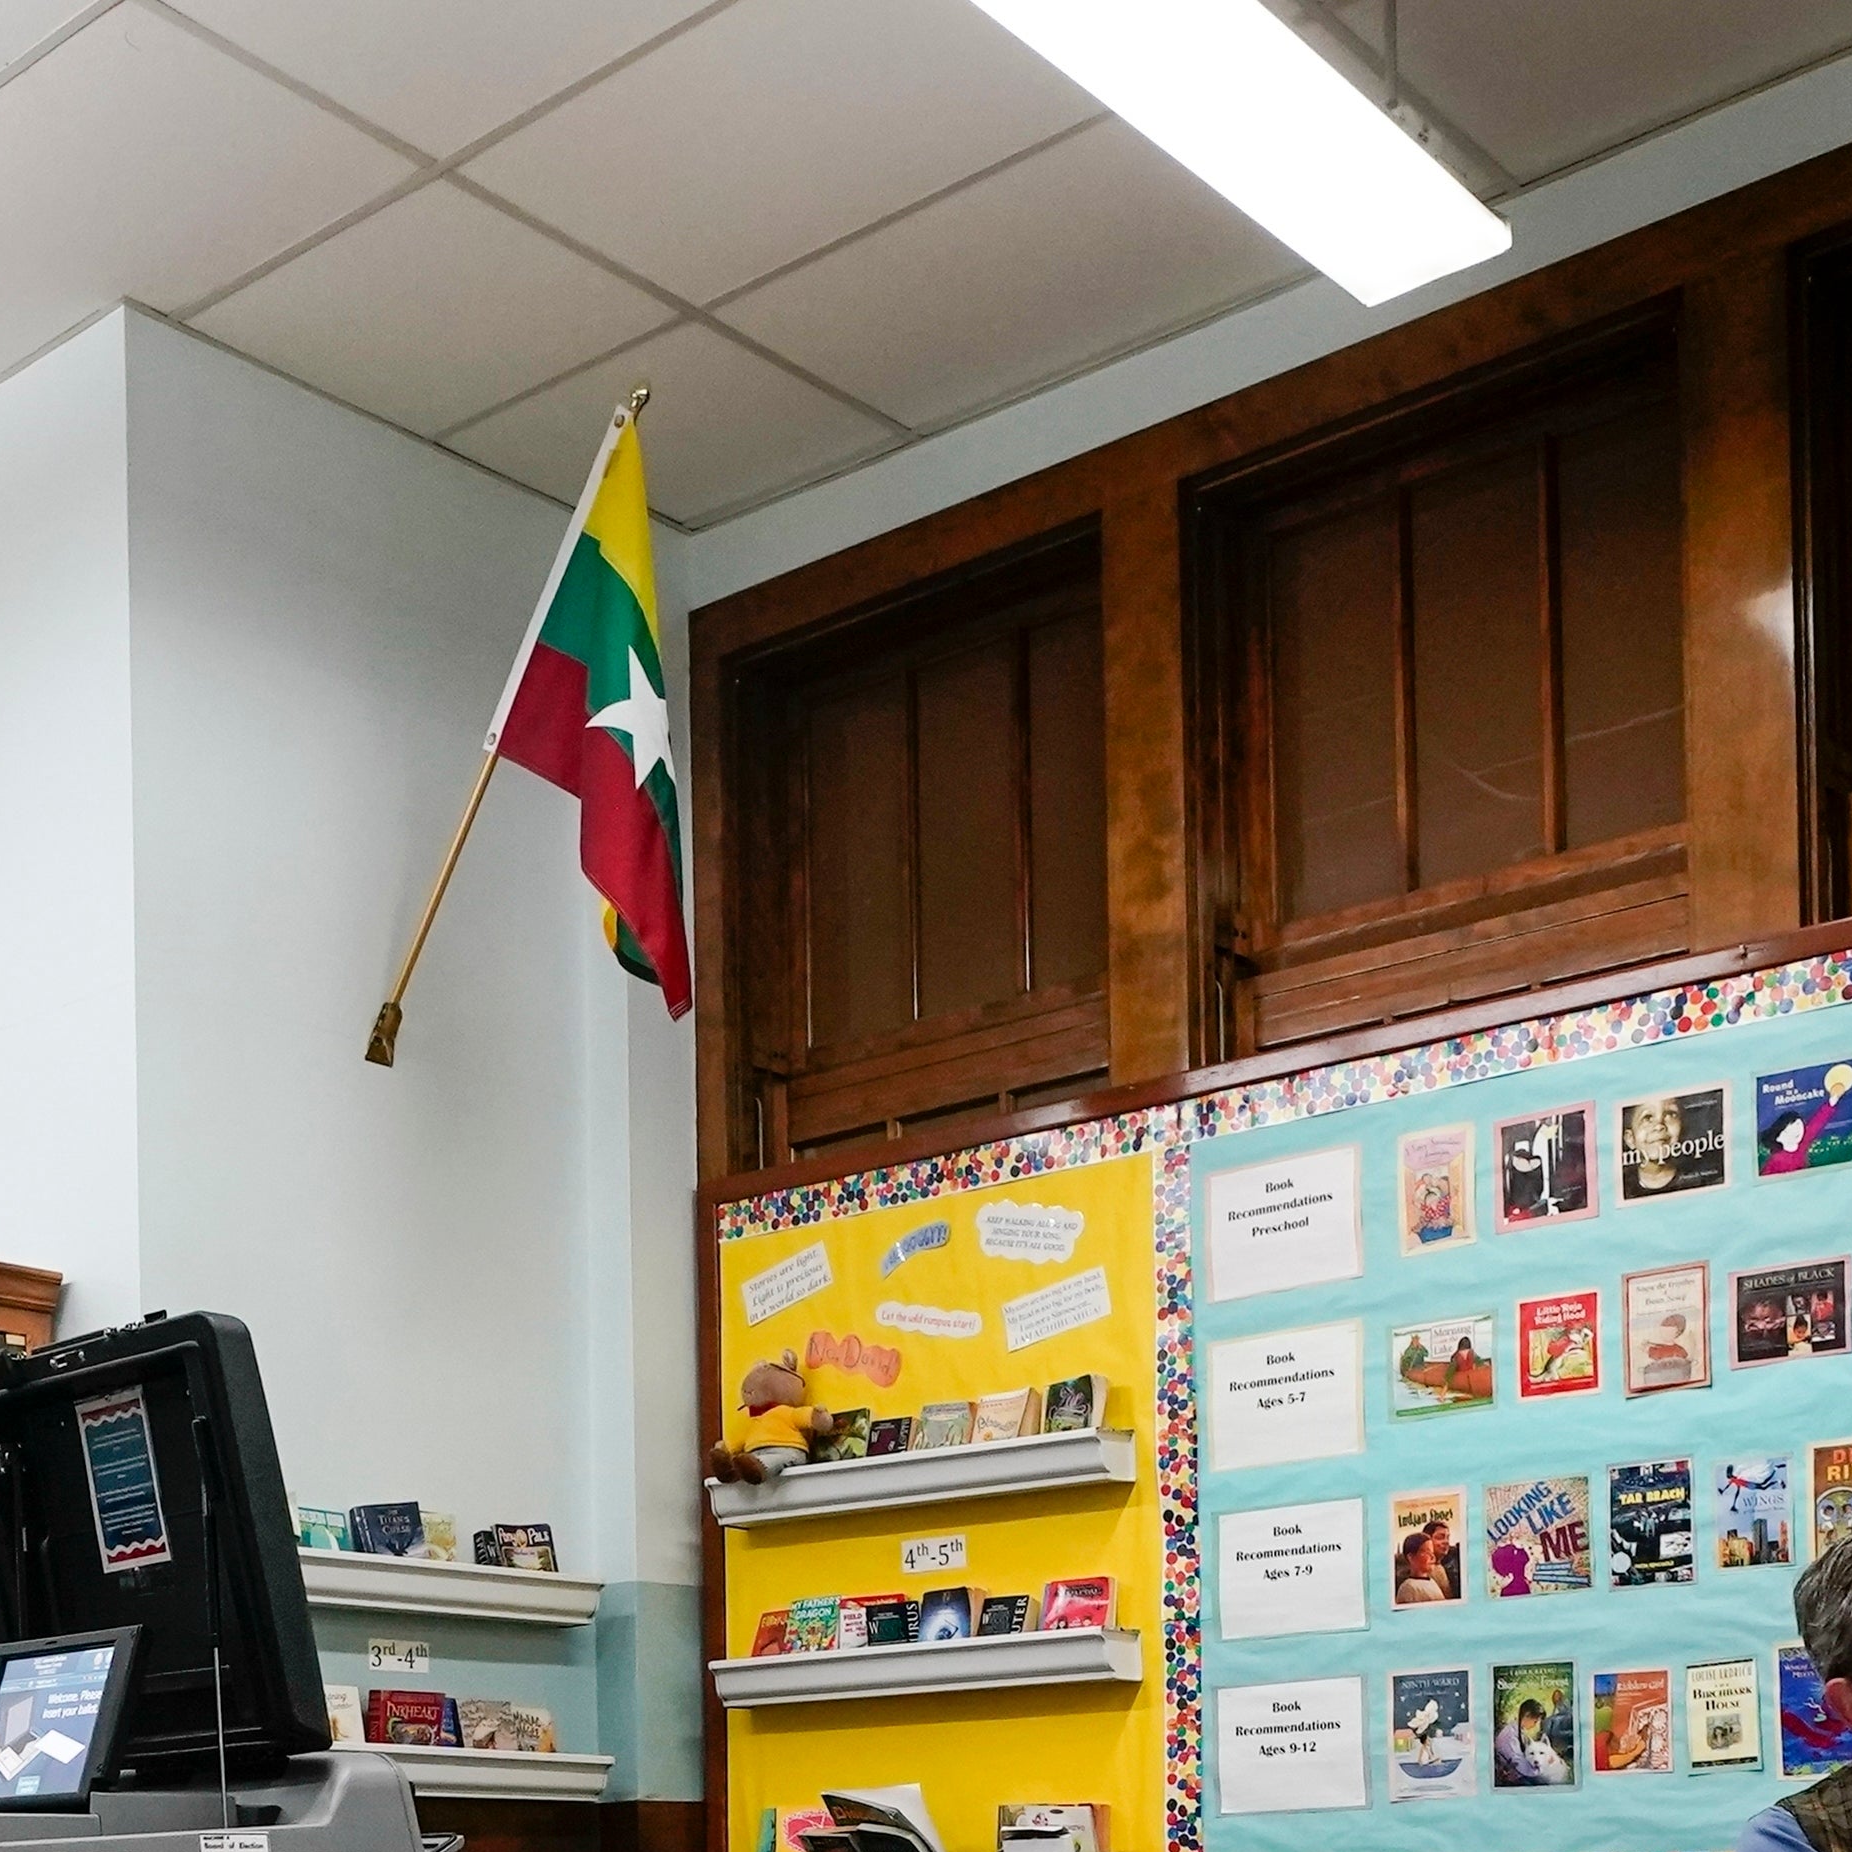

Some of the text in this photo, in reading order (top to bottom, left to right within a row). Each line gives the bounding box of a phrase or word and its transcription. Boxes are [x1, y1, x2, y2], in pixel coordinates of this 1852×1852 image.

[1762, 1079, 1793, 1093] Round
[1775, 1089, 1824, 1105] Mooncake
[1623, 1130, 1724, 1167] my people
[1265, 1179, 1294, 1193] Book
[1228, 1192, 1333, 1222] Recommendations
[1251, 1217, 1309, 1237] Preschool
[1743, 1275, 1786, 1291] SHADES
[1798, 1268, 1835, 1283] BLACK
[1433, 1325, 1472, 1337] Morning
[1266, 1352, 1295, 1366] Book
[1230, 1368, 1335, 1392] Recommendations
[1256, 1392, 1306, 1410] Ages 5-7
[1619, 1487, 1685, 1505] TAR BEACH
[1742, 1495, 1785, 1508] WINGS
[1398, 1510, 1427, 1528] Indian
[1487, 1481, 1552, 1542] LOOKING
[1526, 1491, 1576, 1535] LIKE
[528, 1528, 549, 1543] Pals
[1273, 1525, 1302, 1537] Book
[1539, 1520, 1589, 1562] ME
[904, 1538, 963, 1569] 4th-5th
[1236, 1542, 1342, 1562] Recommendations
[1263, 1565, 1313, 1581] Ages 7-9
[796, 1608, 832, 1618] DRAGON
[371, 1643, 428, 1668] 3rd-4th
[1401, 1678, 1460, 1689] NINTH WARD
[1692, 1686, 1752, 1700] BIRCHBARK
[386, 1702, 440, 1720] INKHEART
[1272, 1701, 1301, 1713] Book
[1705, 1700, 1741, 1711] HOUSE
[1235, 1719, 1341, 1736] Recommendations
[1259, 1741, 1317, 1757] Ages 9-12
